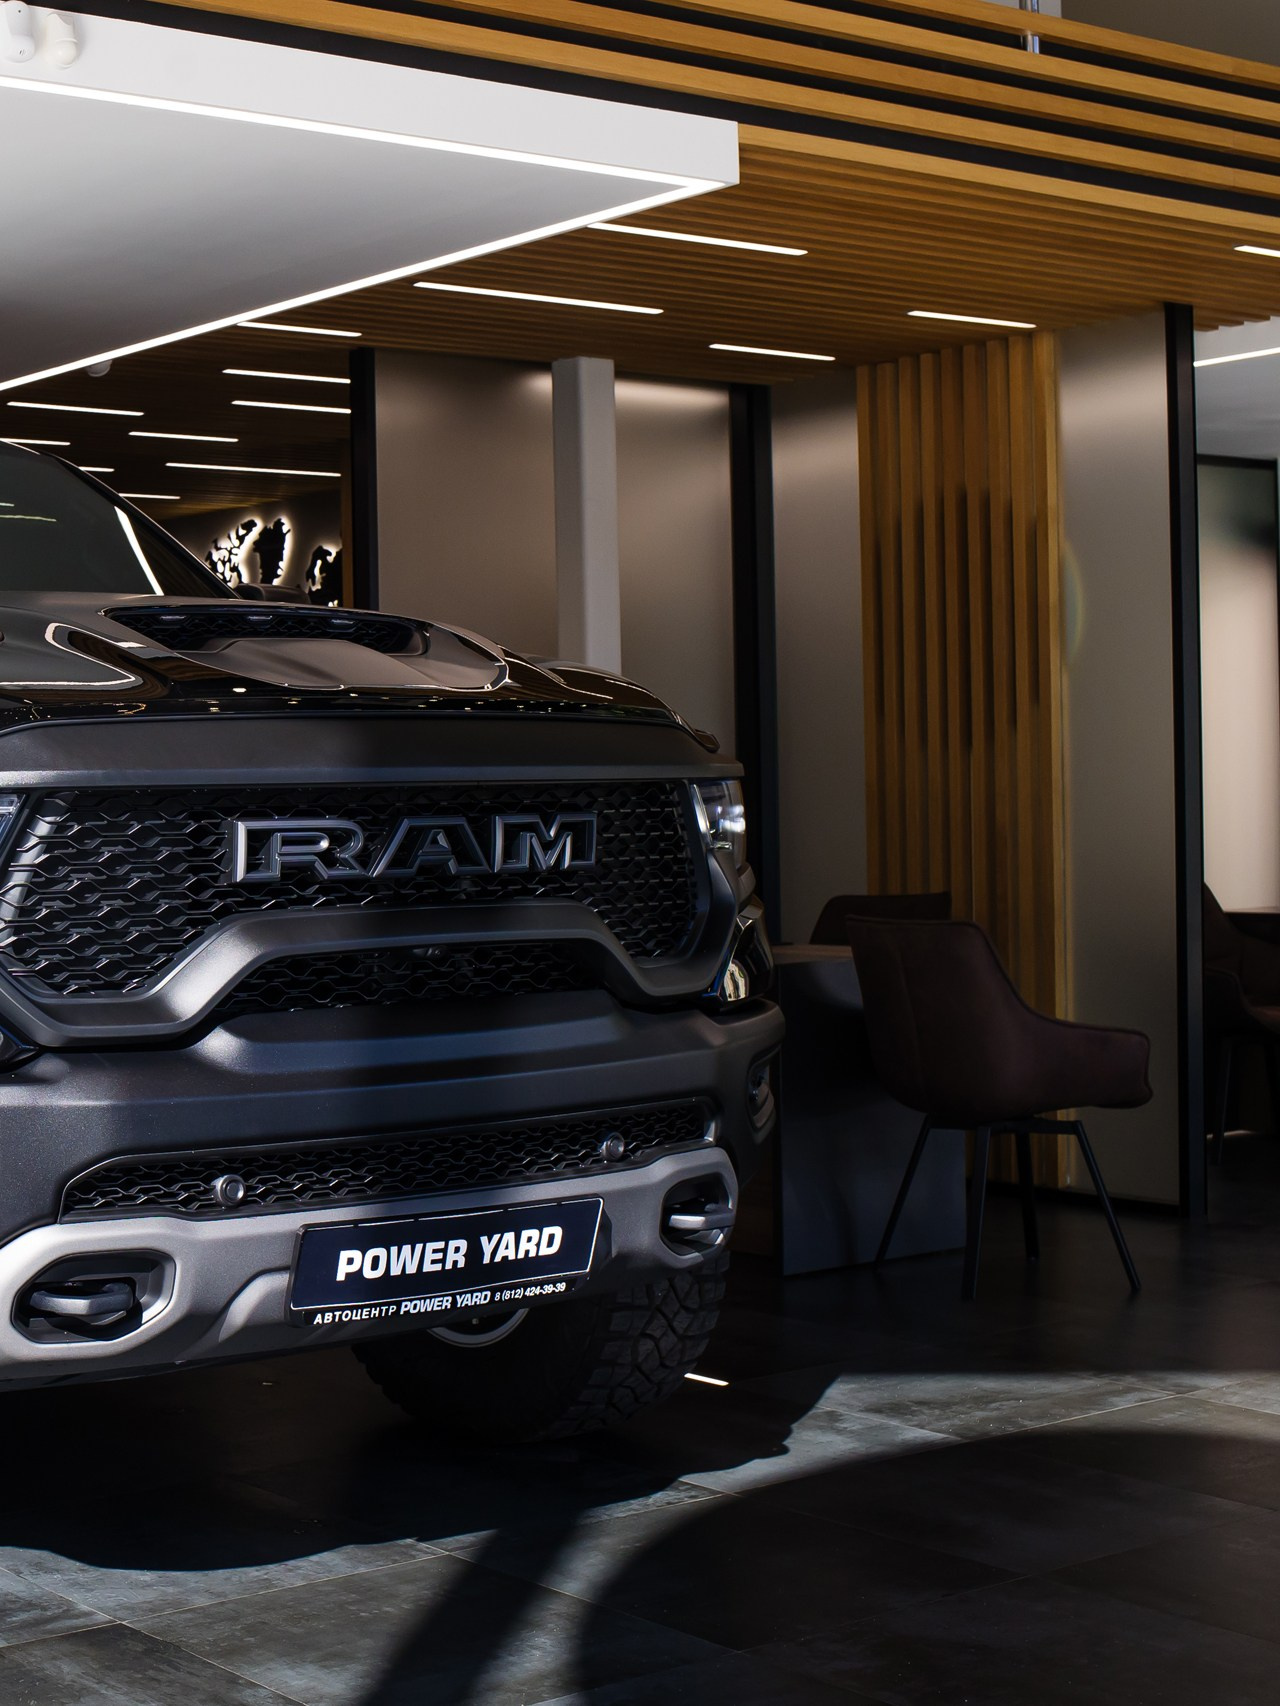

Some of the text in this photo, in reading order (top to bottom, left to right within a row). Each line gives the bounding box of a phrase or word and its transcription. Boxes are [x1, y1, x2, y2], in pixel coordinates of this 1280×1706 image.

[232, 810, 598, 885] RAM
[335, 1225, 563, 1282] POWER YARD
[313, 1281, 567, 1325] АВТОЦЕНТР POWER YARD 8 (812) 424-39-39
